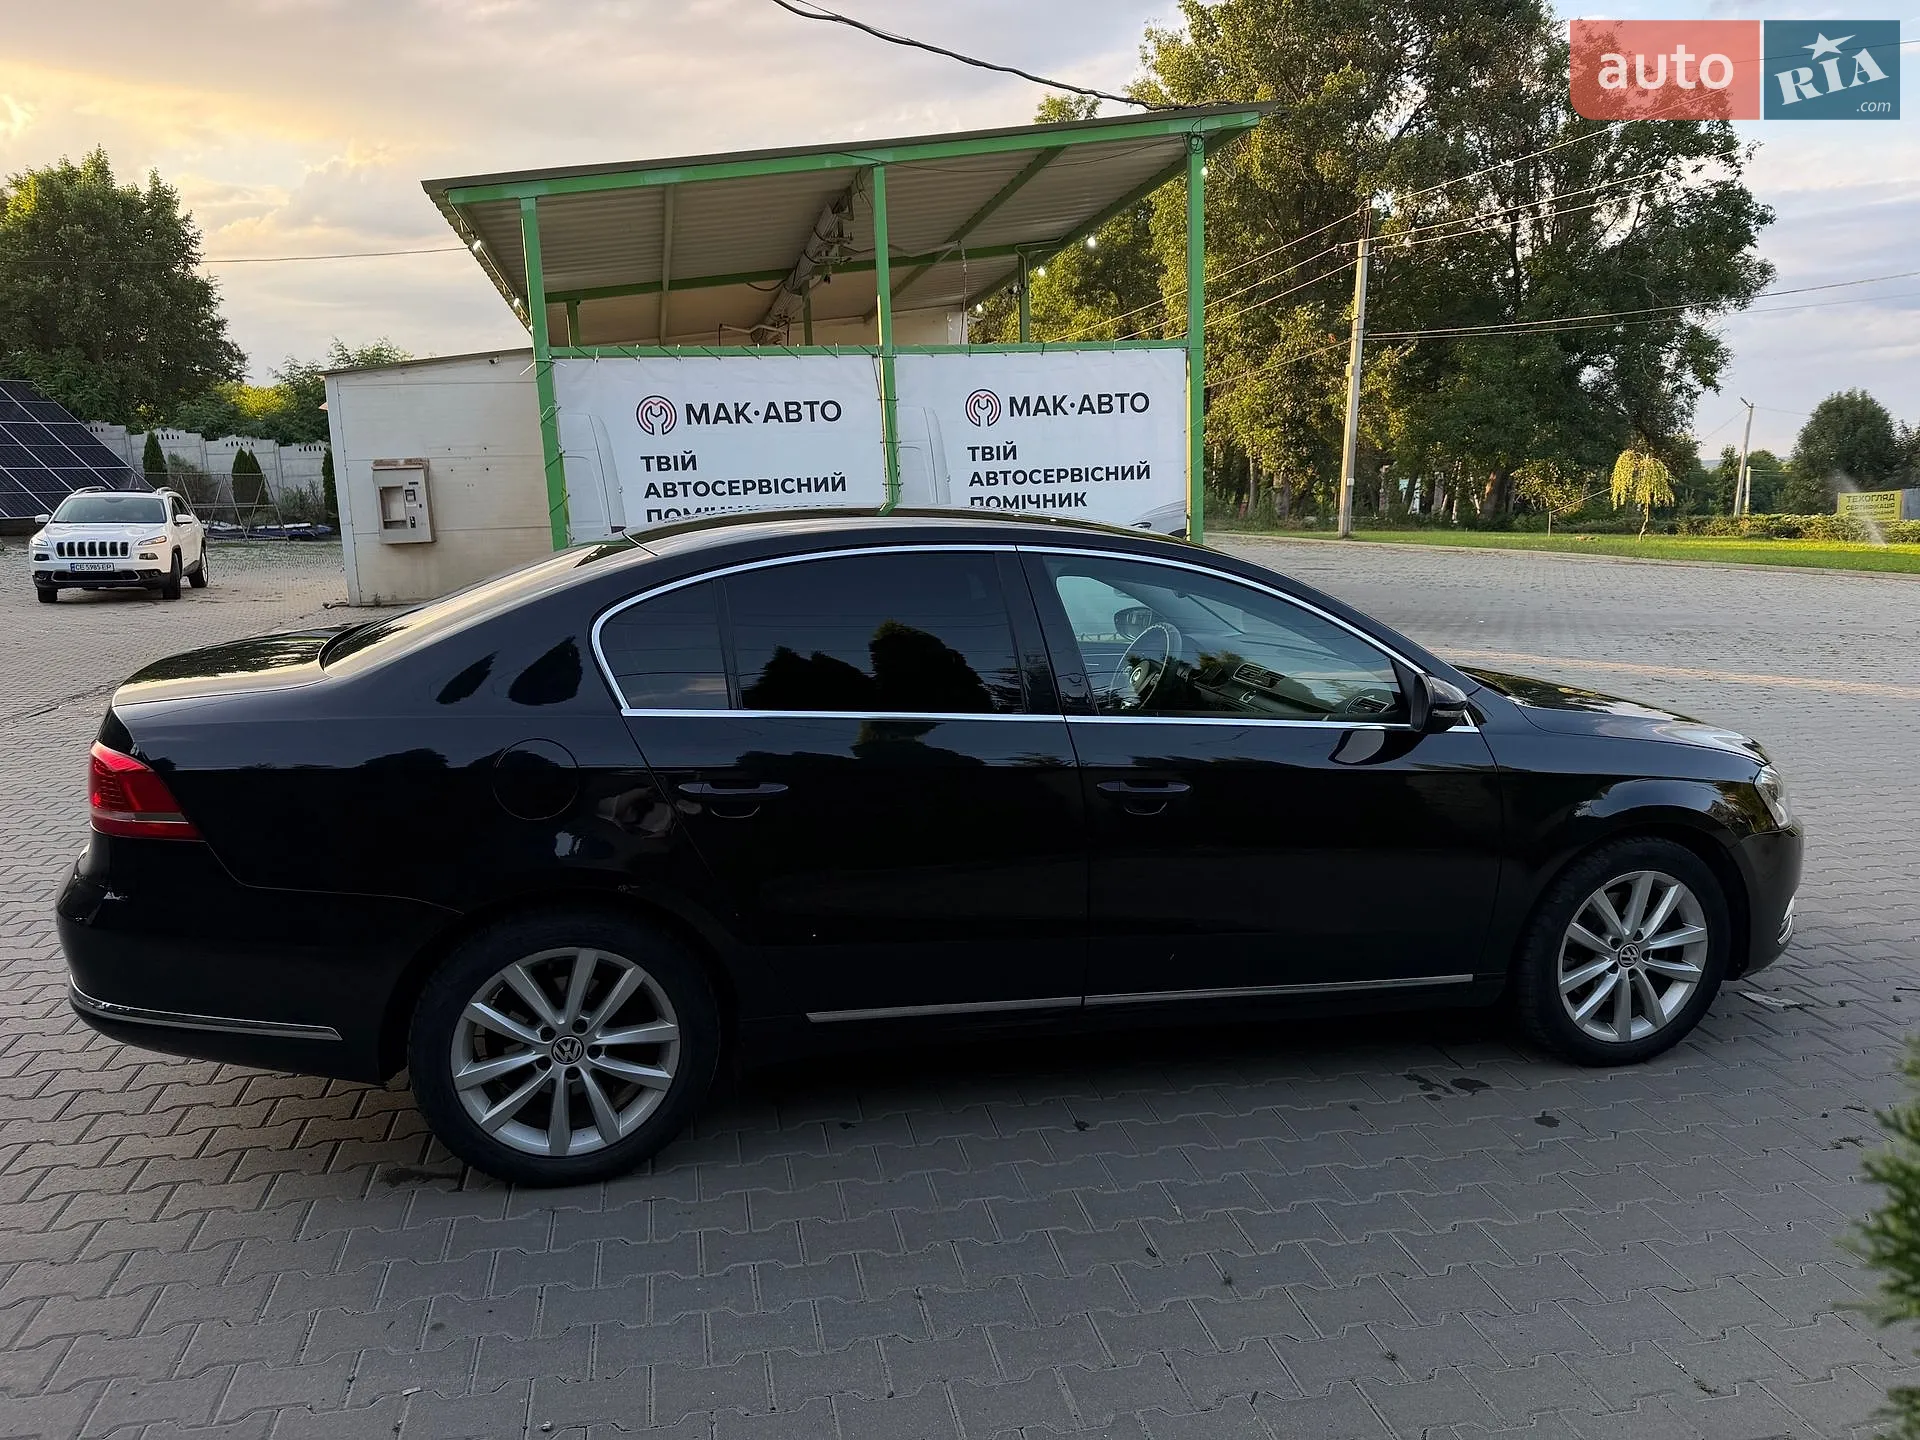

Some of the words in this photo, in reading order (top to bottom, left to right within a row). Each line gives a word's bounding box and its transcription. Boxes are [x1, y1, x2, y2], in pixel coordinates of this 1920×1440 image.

[640, 449, 698, 472] ТВІЙ
[967, 440, 1018, 462] ТВІЙ
[644, 471, 847, 499] АВТОСЕРВІСНИЙ
[968, 460, 1151, 488] АВТОСЕРВІСНИЙ
[970, 492, 1088, 510] ПОМІЧНИК
[1846, 493, 1895, 503] ТЕХОГЛЯД
